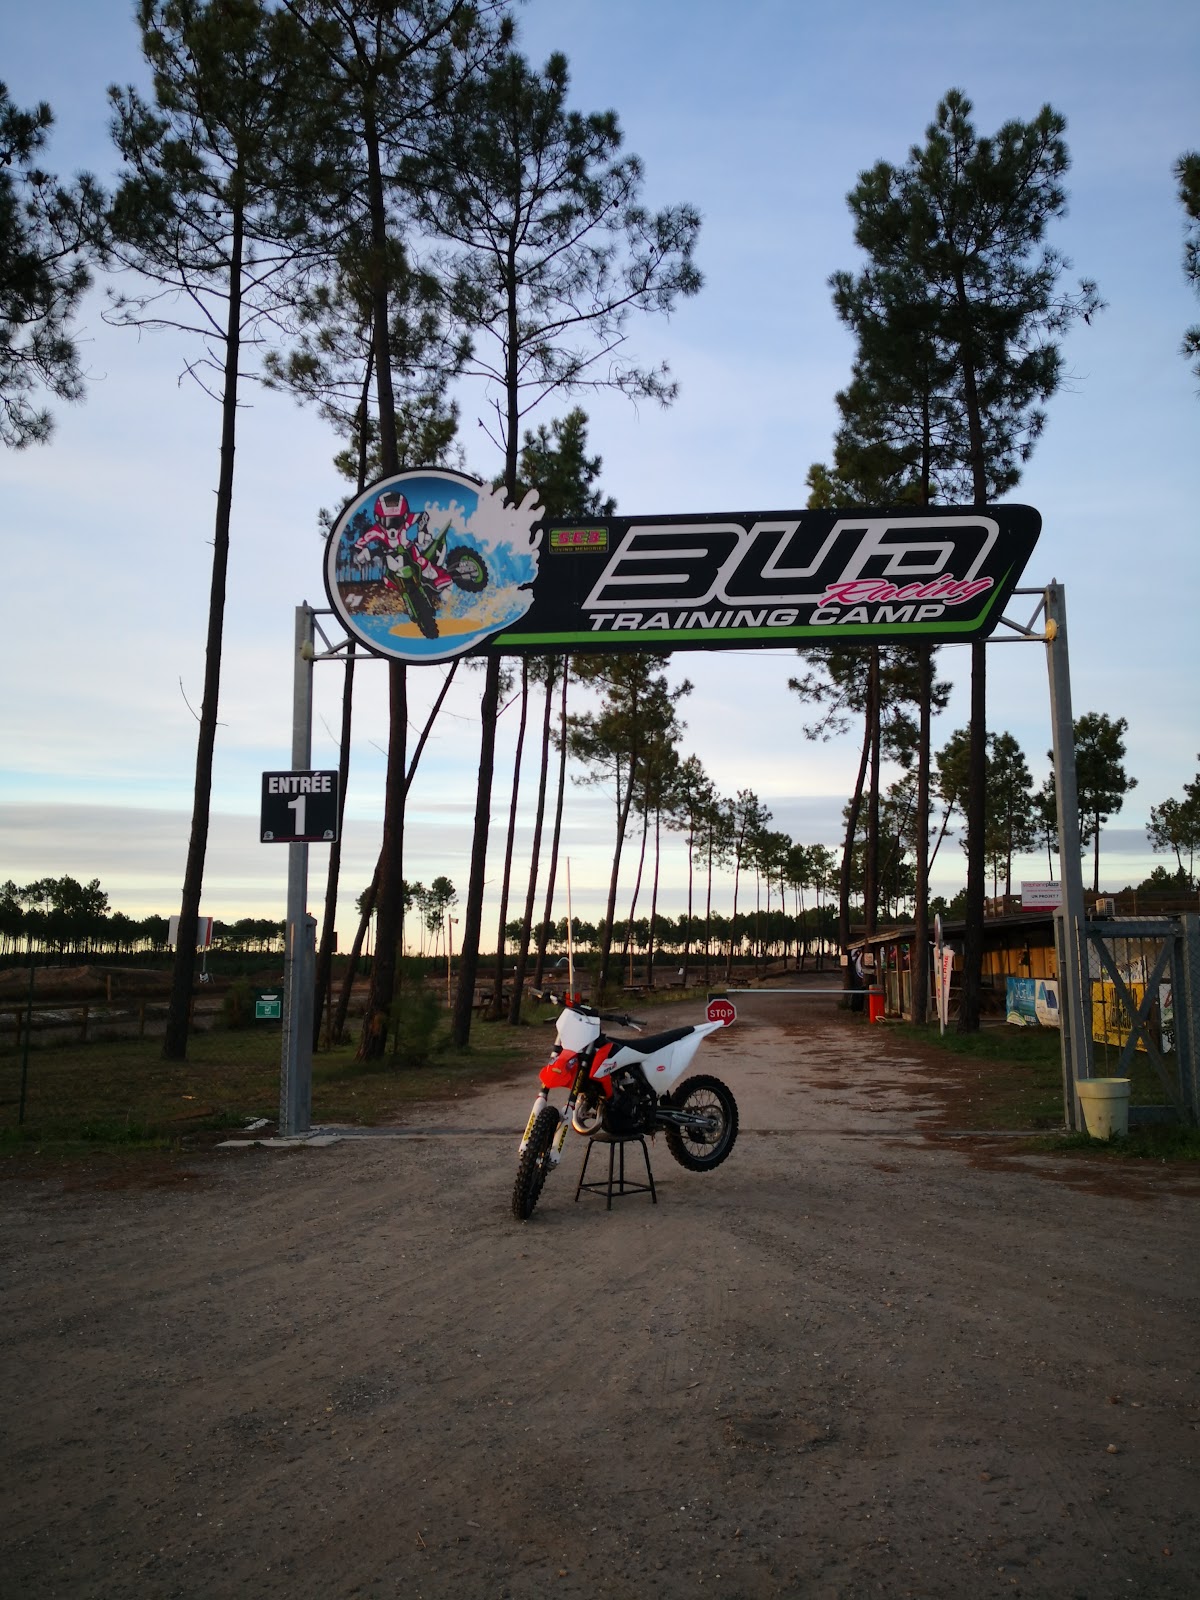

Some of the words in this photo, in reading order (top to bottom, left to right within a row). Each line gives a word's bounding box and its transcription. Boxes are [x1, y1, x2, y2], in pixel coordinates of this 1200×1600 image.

[581, 515, 1000, 610] BUD
[817, 573, 994, 608] Racing
[588, 608, 800, 631] TRAINING
[808, 604, 946, 625] CAMP
[268, 772, 331, 793] ENTRÉE
[287, 795, 306, 836] 1
[710, 1009, 734, 1018] STOP
